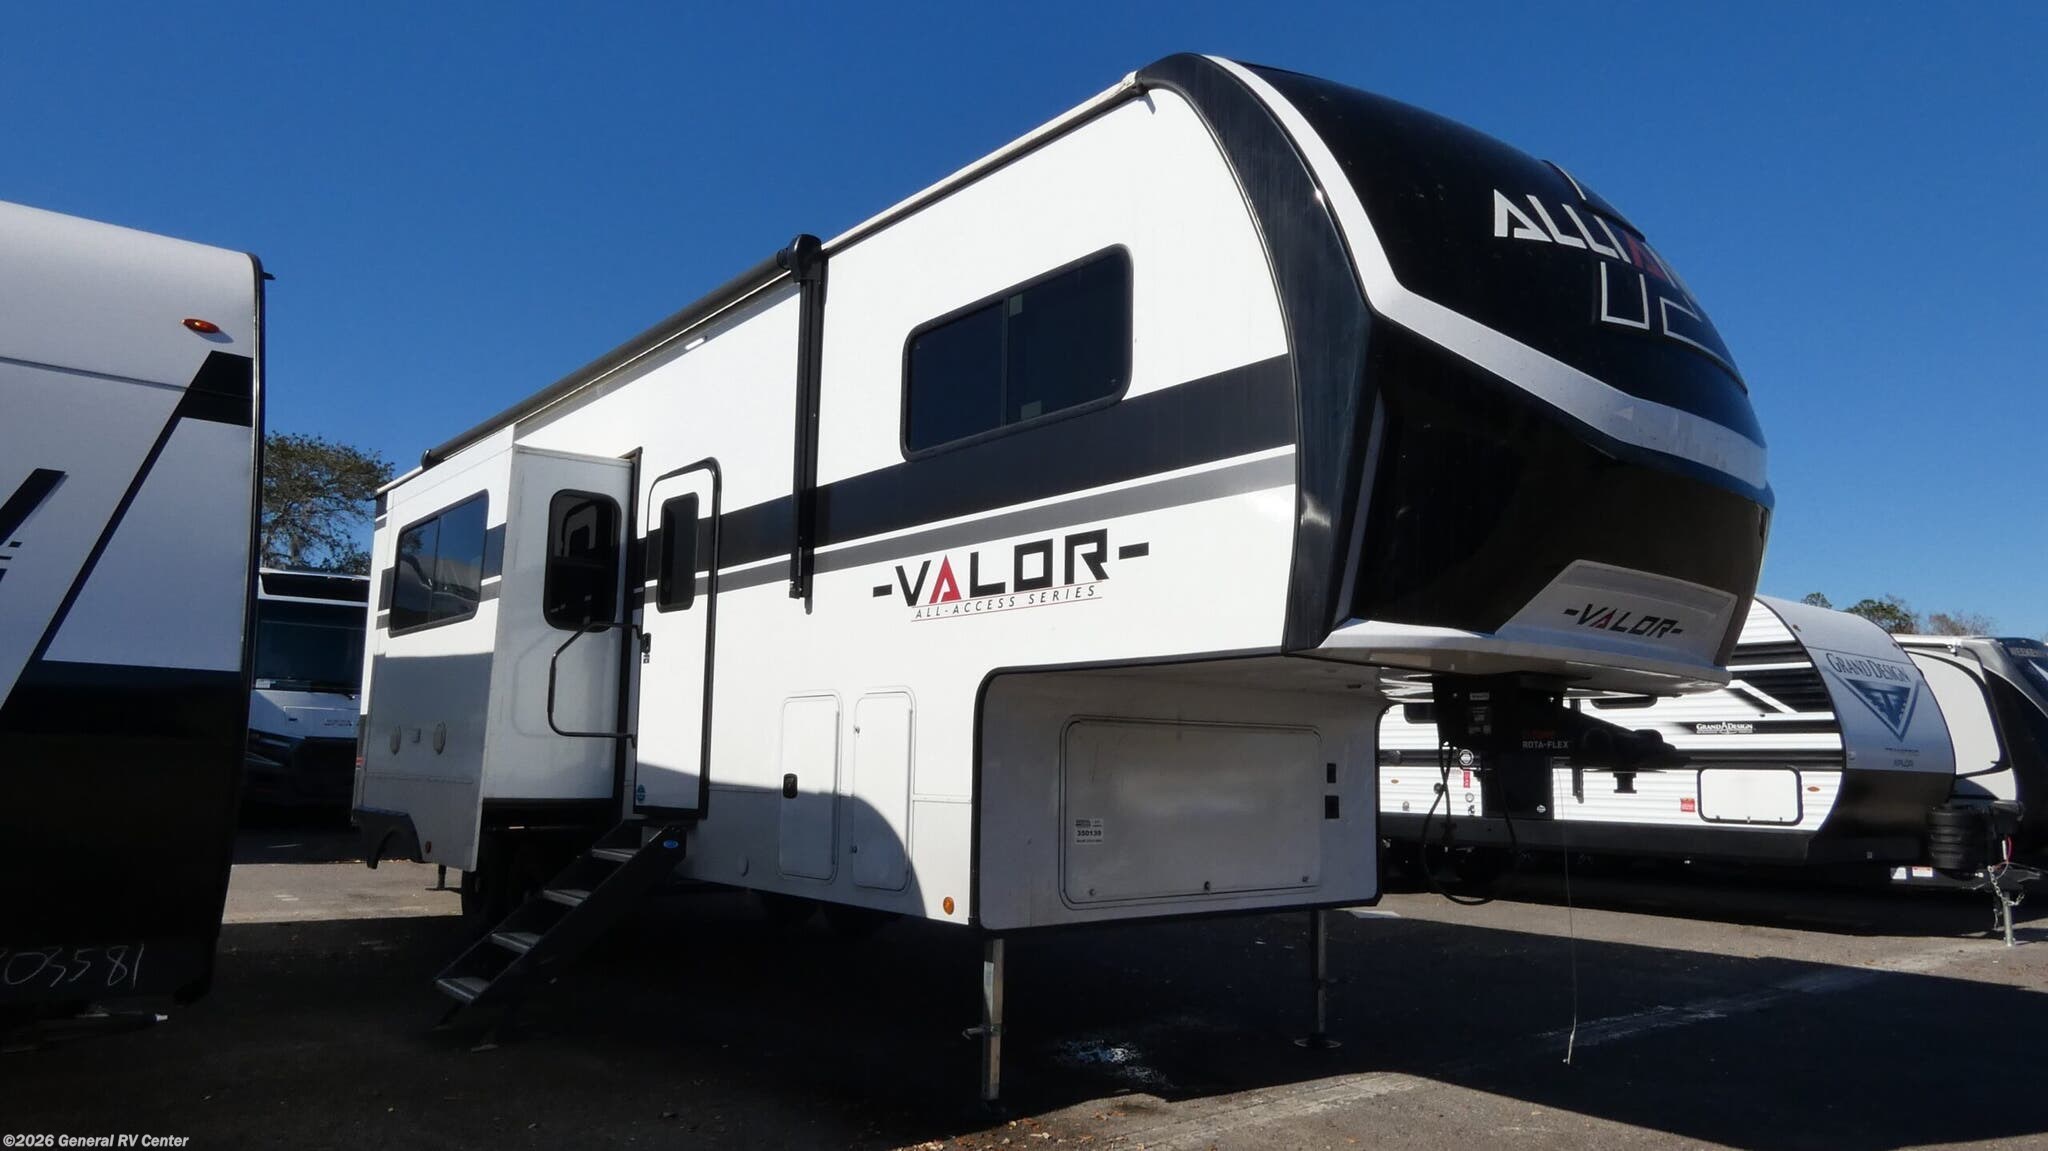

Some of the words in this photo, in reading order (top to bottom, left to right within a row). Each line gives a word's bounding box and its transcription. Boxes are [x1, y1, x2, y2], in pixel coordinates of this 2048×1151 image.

[915, 597, 1015, 619] ALL-ACCESS
[1028, 585, 1096, 606] SERIES
[1826, 653, 1872, 677] GRAND
[1866, 660, 1912, 682] DESIGN
